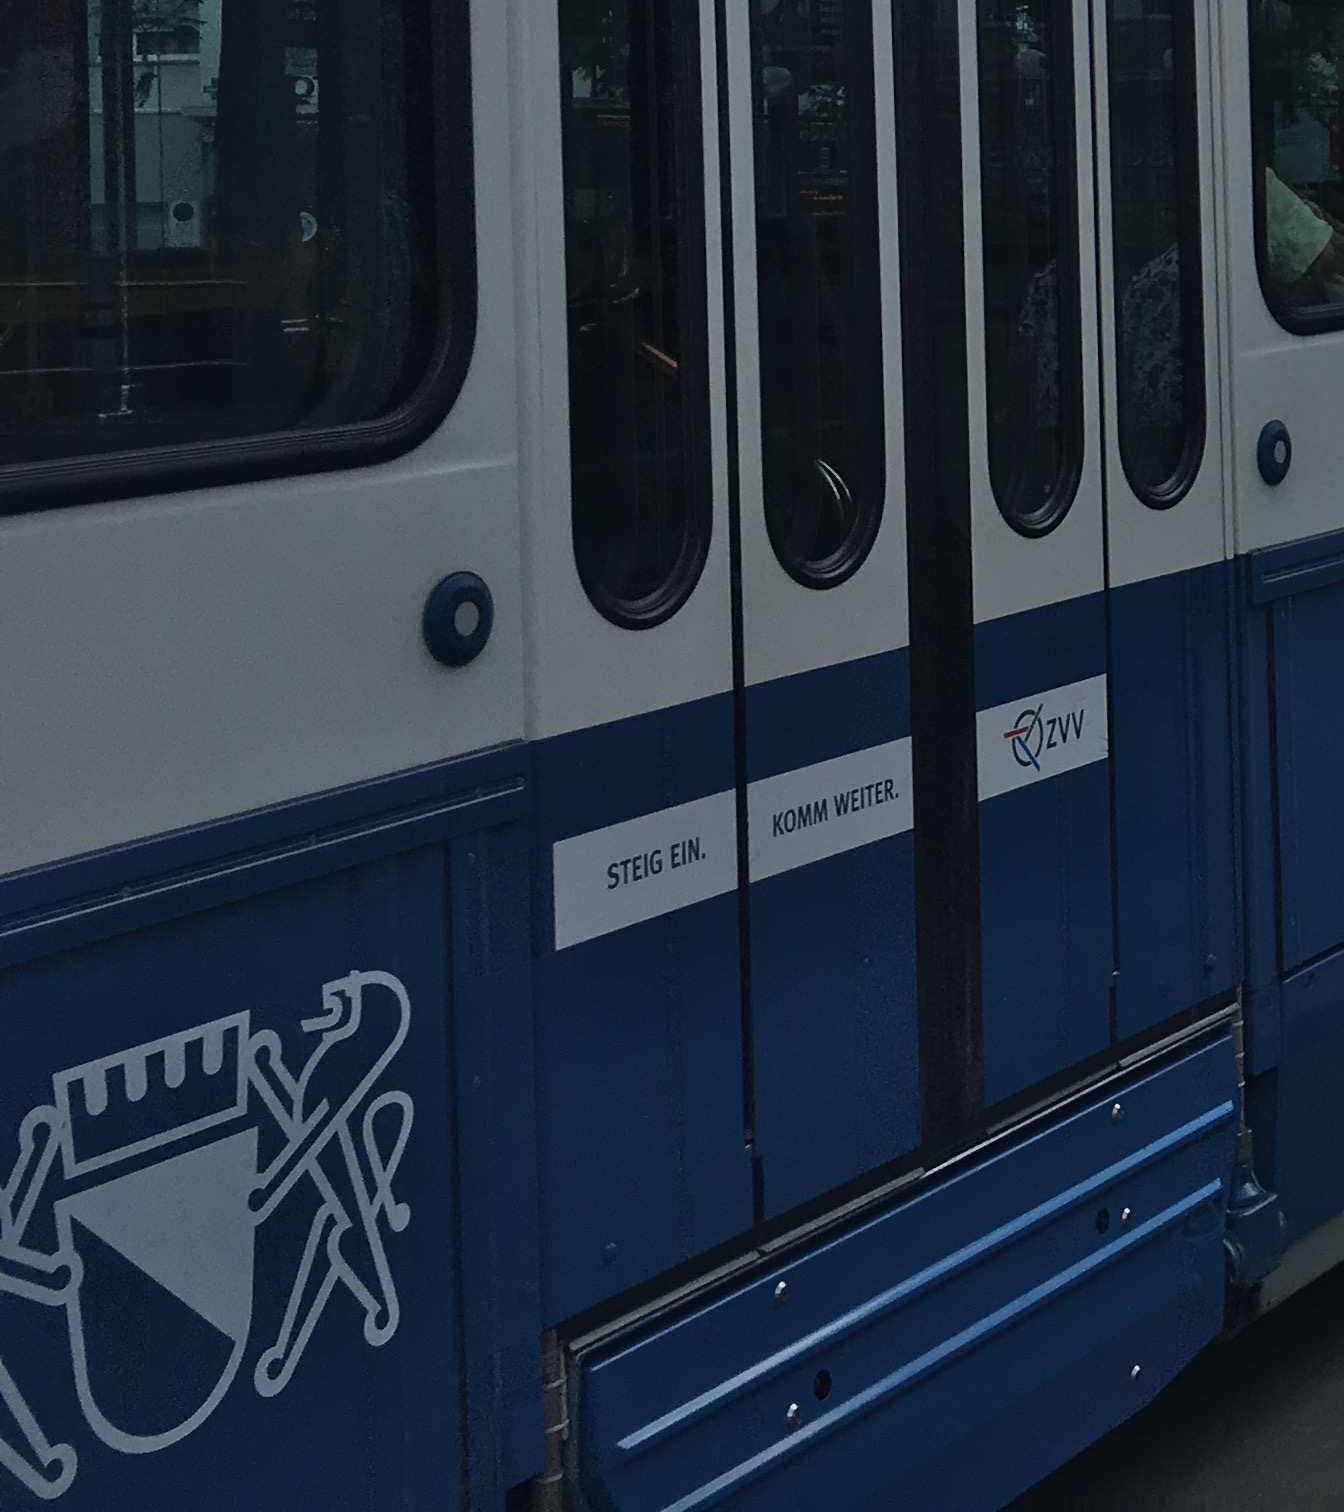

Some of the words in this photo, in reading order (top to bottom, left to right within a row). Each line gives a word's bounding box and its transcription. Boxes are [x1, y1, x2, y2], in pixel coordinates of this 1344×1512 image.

[1045, 708, 1086, 749] ZVV
[772, 798, 829, 838] KOMM
[833, 778, 900, 818] WEITER.
[606, 849, 663, 890] STEIG
[670, 837, 707, 870] EIN.
